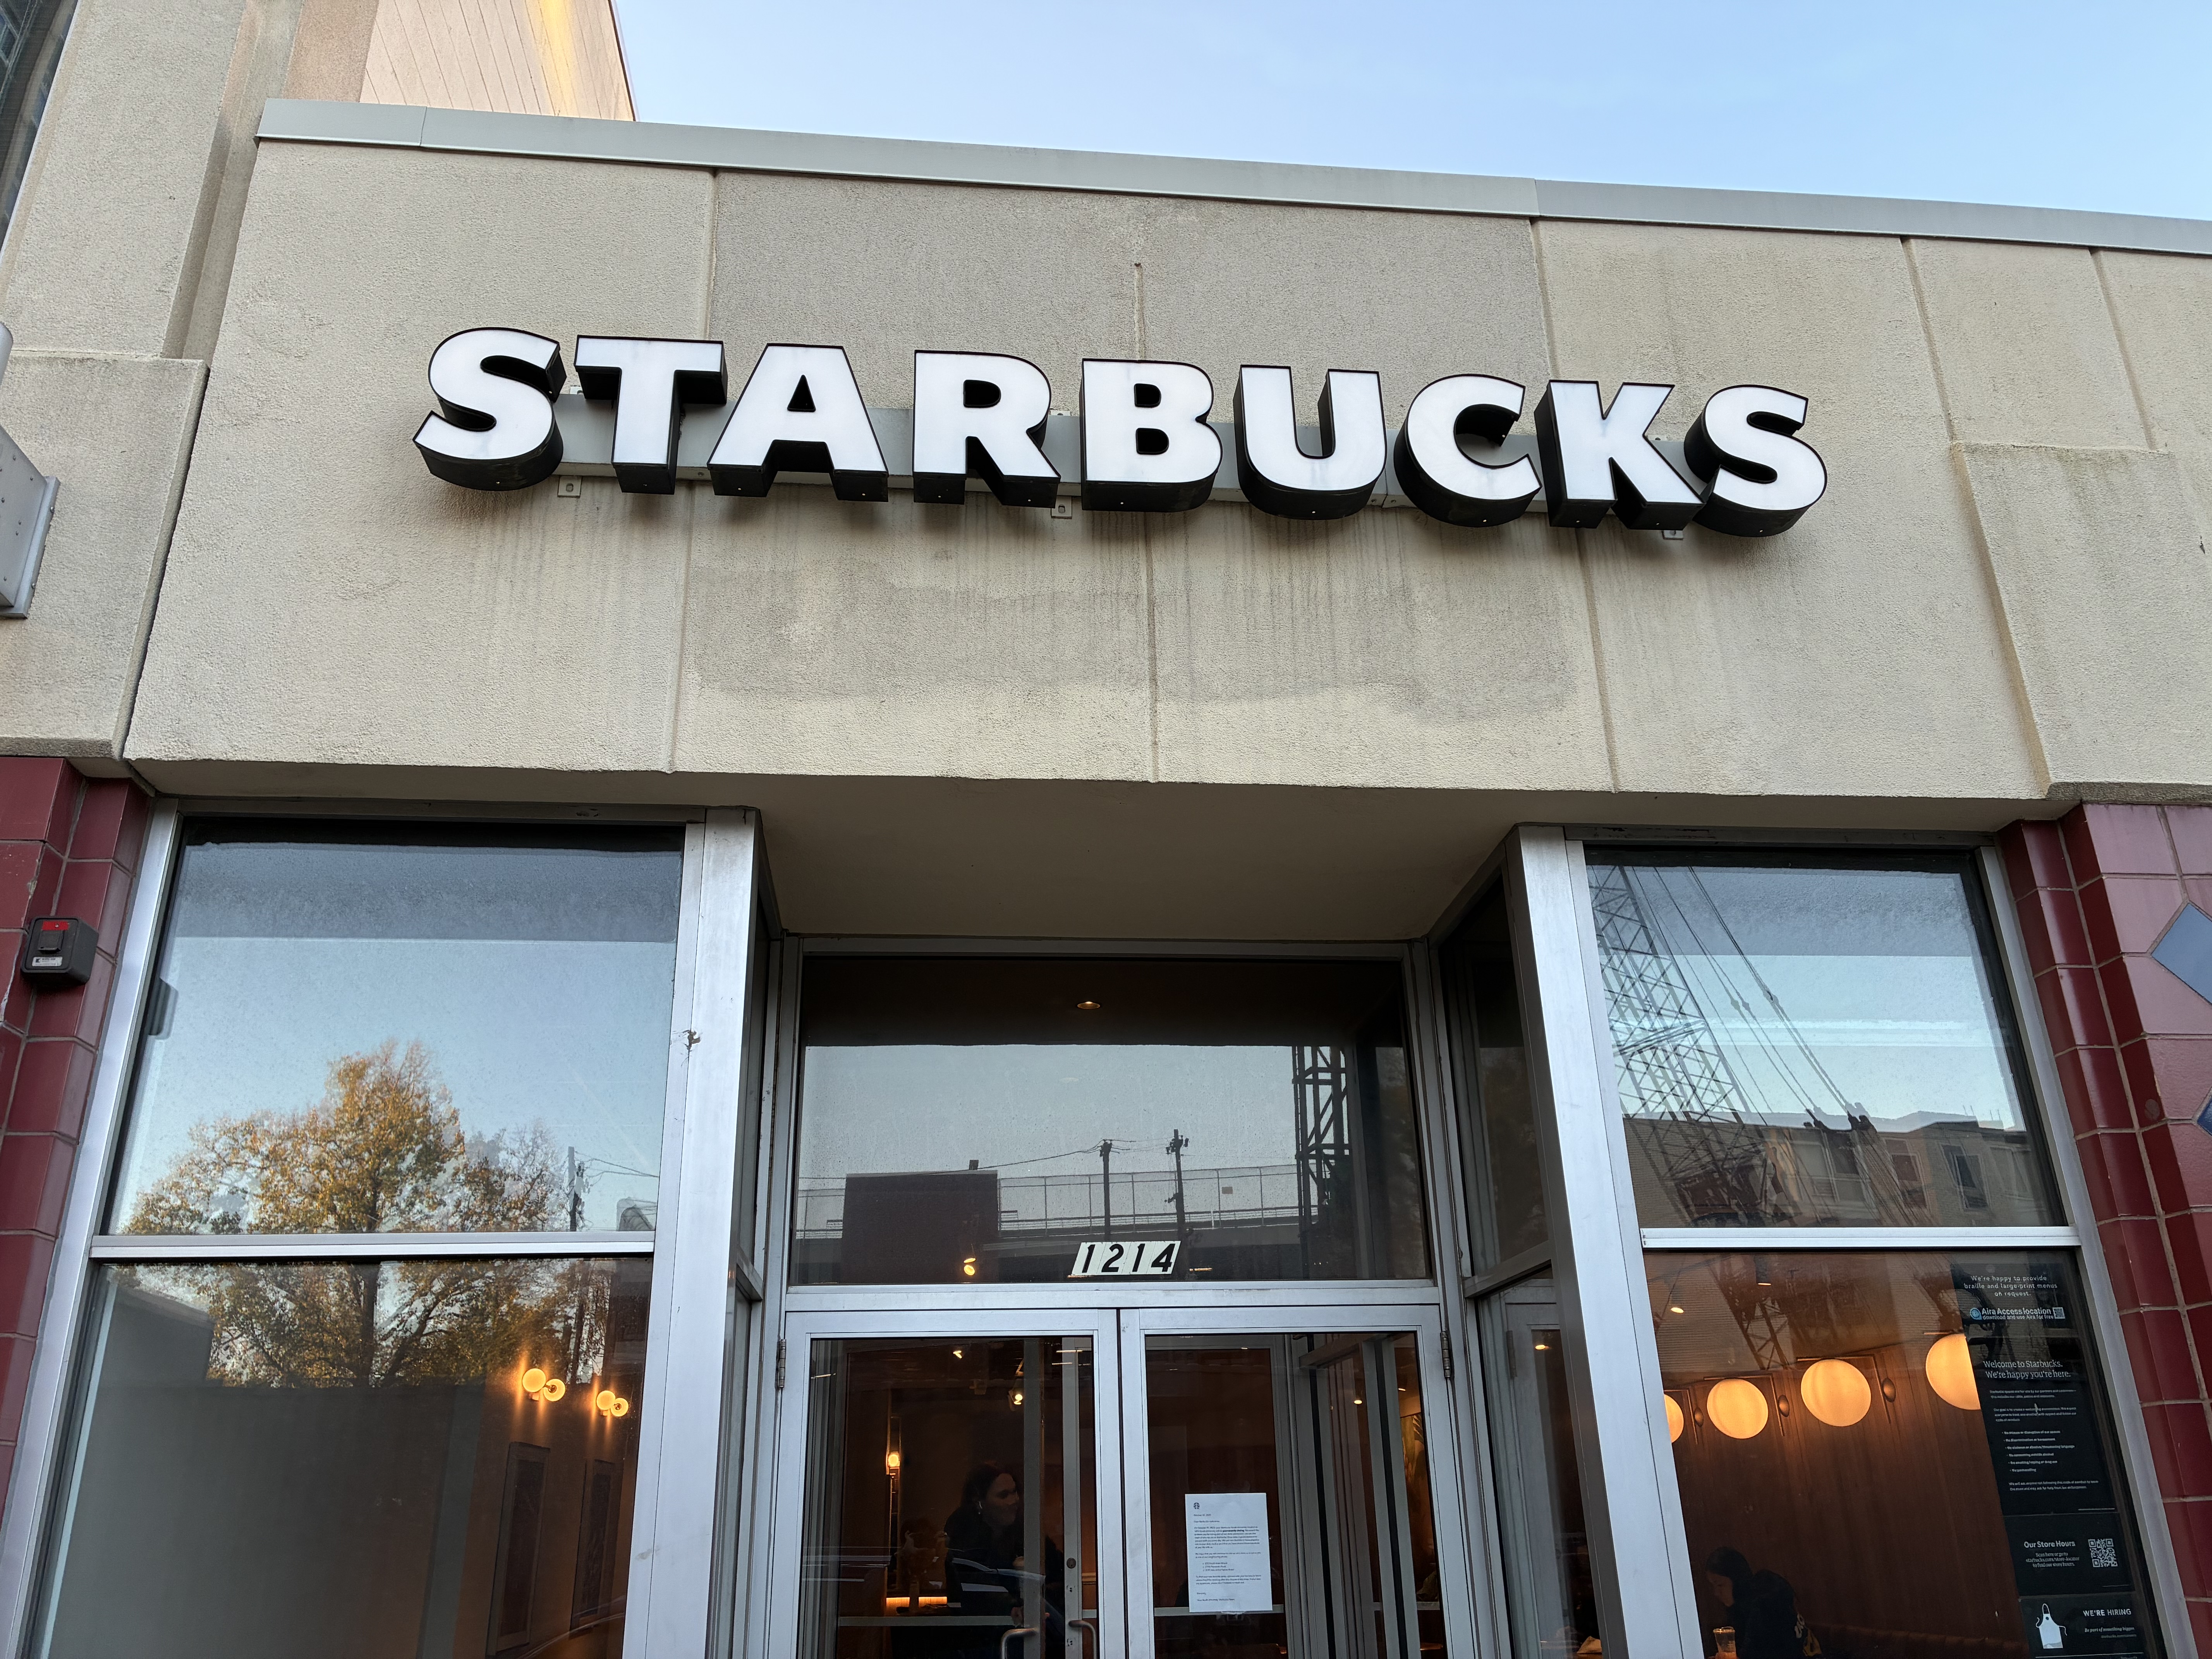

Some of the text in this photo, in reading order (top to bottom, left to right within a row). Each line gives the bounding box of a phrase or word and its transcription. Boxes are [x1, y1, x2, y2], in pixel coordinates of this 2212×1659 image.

[412, 327, 1827, 534] STARBUCKS
[1082, 1243, 1176, 1273] 1214
[2007, 1370, 2029, 1379] happy
[2030, 1370, 2052, 1379] you're
